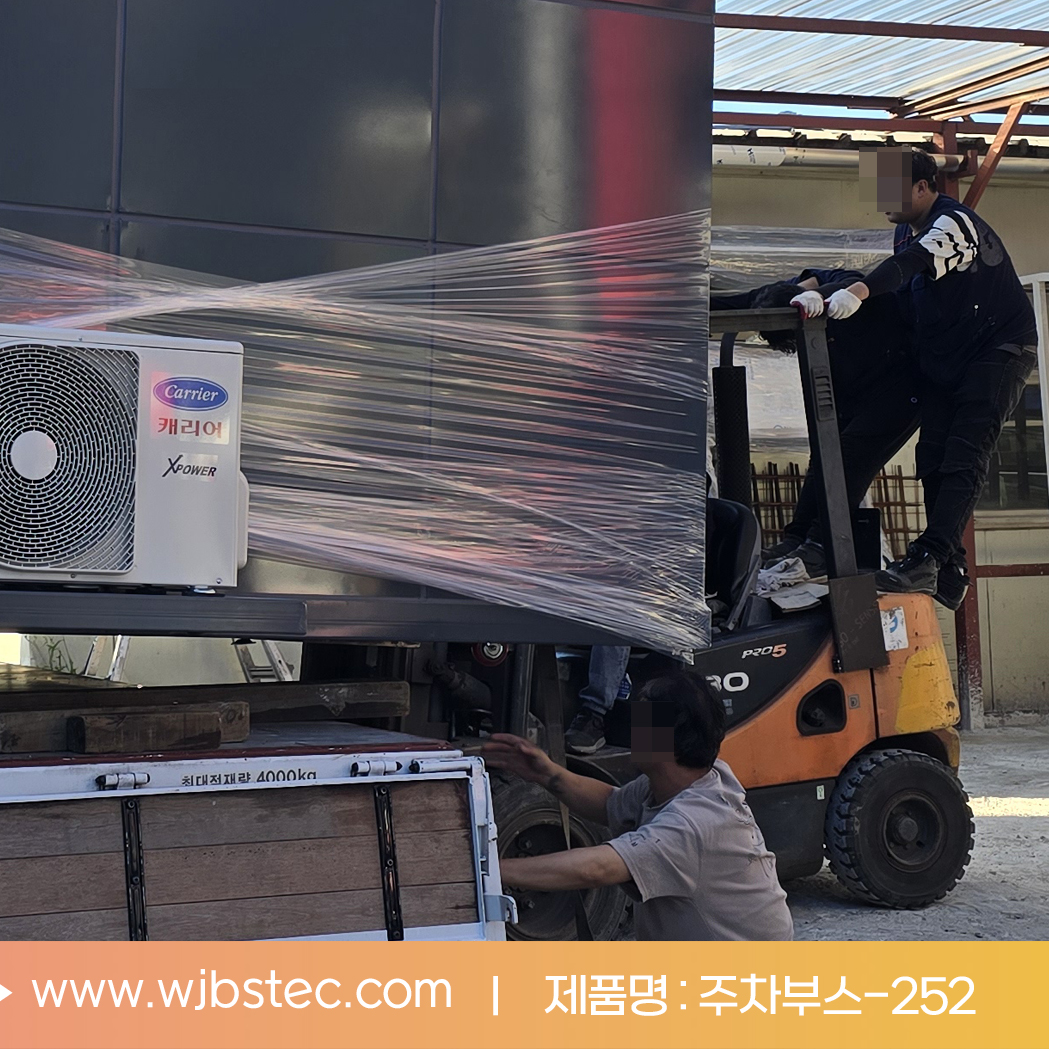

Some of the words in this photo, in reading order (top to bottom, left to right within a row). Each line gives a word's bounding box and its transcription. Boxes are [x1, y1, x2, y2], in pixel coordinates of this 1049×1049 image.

[164, 384, 219, 402] Carrier
[157, 417, 222, 439] 캐리어
[162, 454, 217, 478] XPOWER
